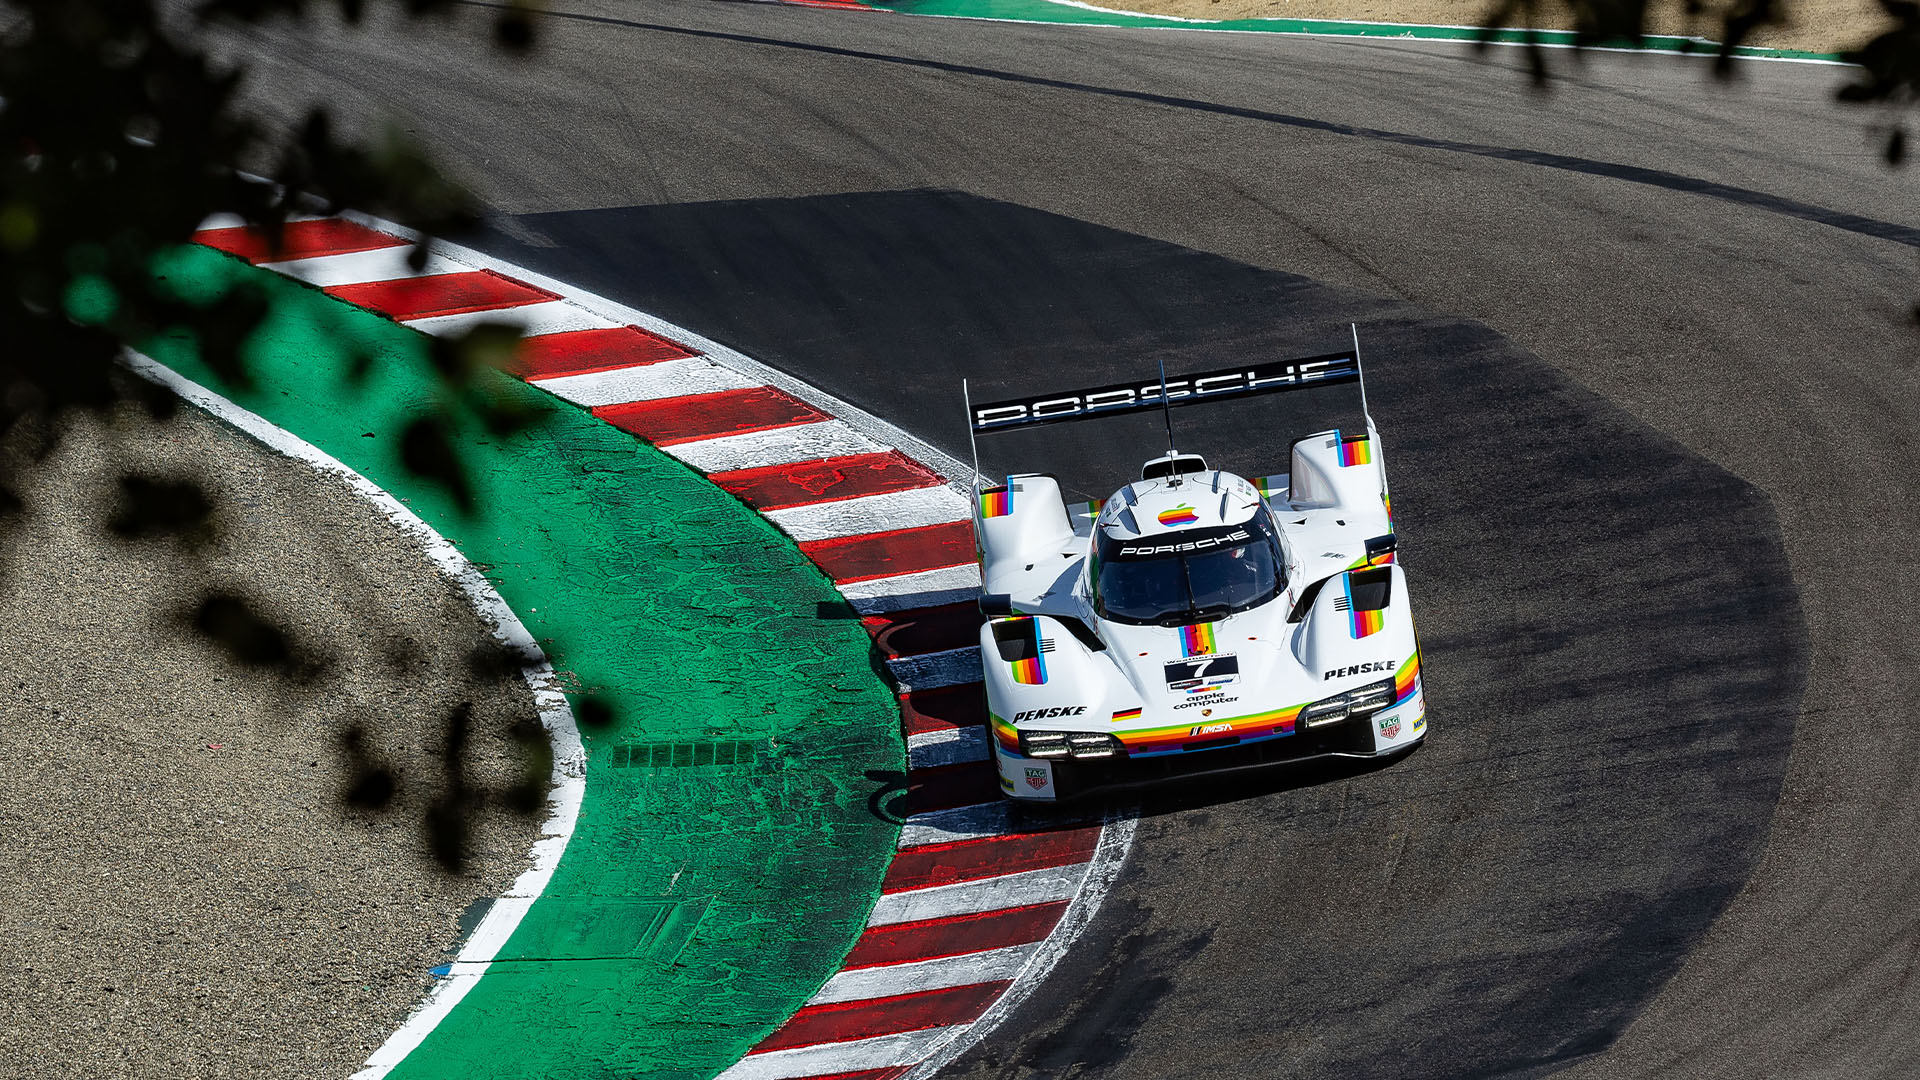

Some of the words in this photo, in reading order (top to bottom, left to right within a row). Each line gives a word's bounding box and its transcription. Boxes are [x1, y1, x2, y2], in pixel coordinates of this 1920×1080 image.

[977, 357, 1352, 427] PORSCHE
[1120, 530, 1250, 556] PORSCHE
[1186, 659, 1214, 678] 7
[1324, 660, 1396, 681] PENSKE
[1173, 696, 1239, 710] computer
[1186, 692, 1225, 702] apple
[1012, 706, 1088, 724] PENSKE
[1382, 716, 1399, 729] TAG
[1202, 723, 1233, 735] IMSA
[1027, 769, 1045, 778] TAG
